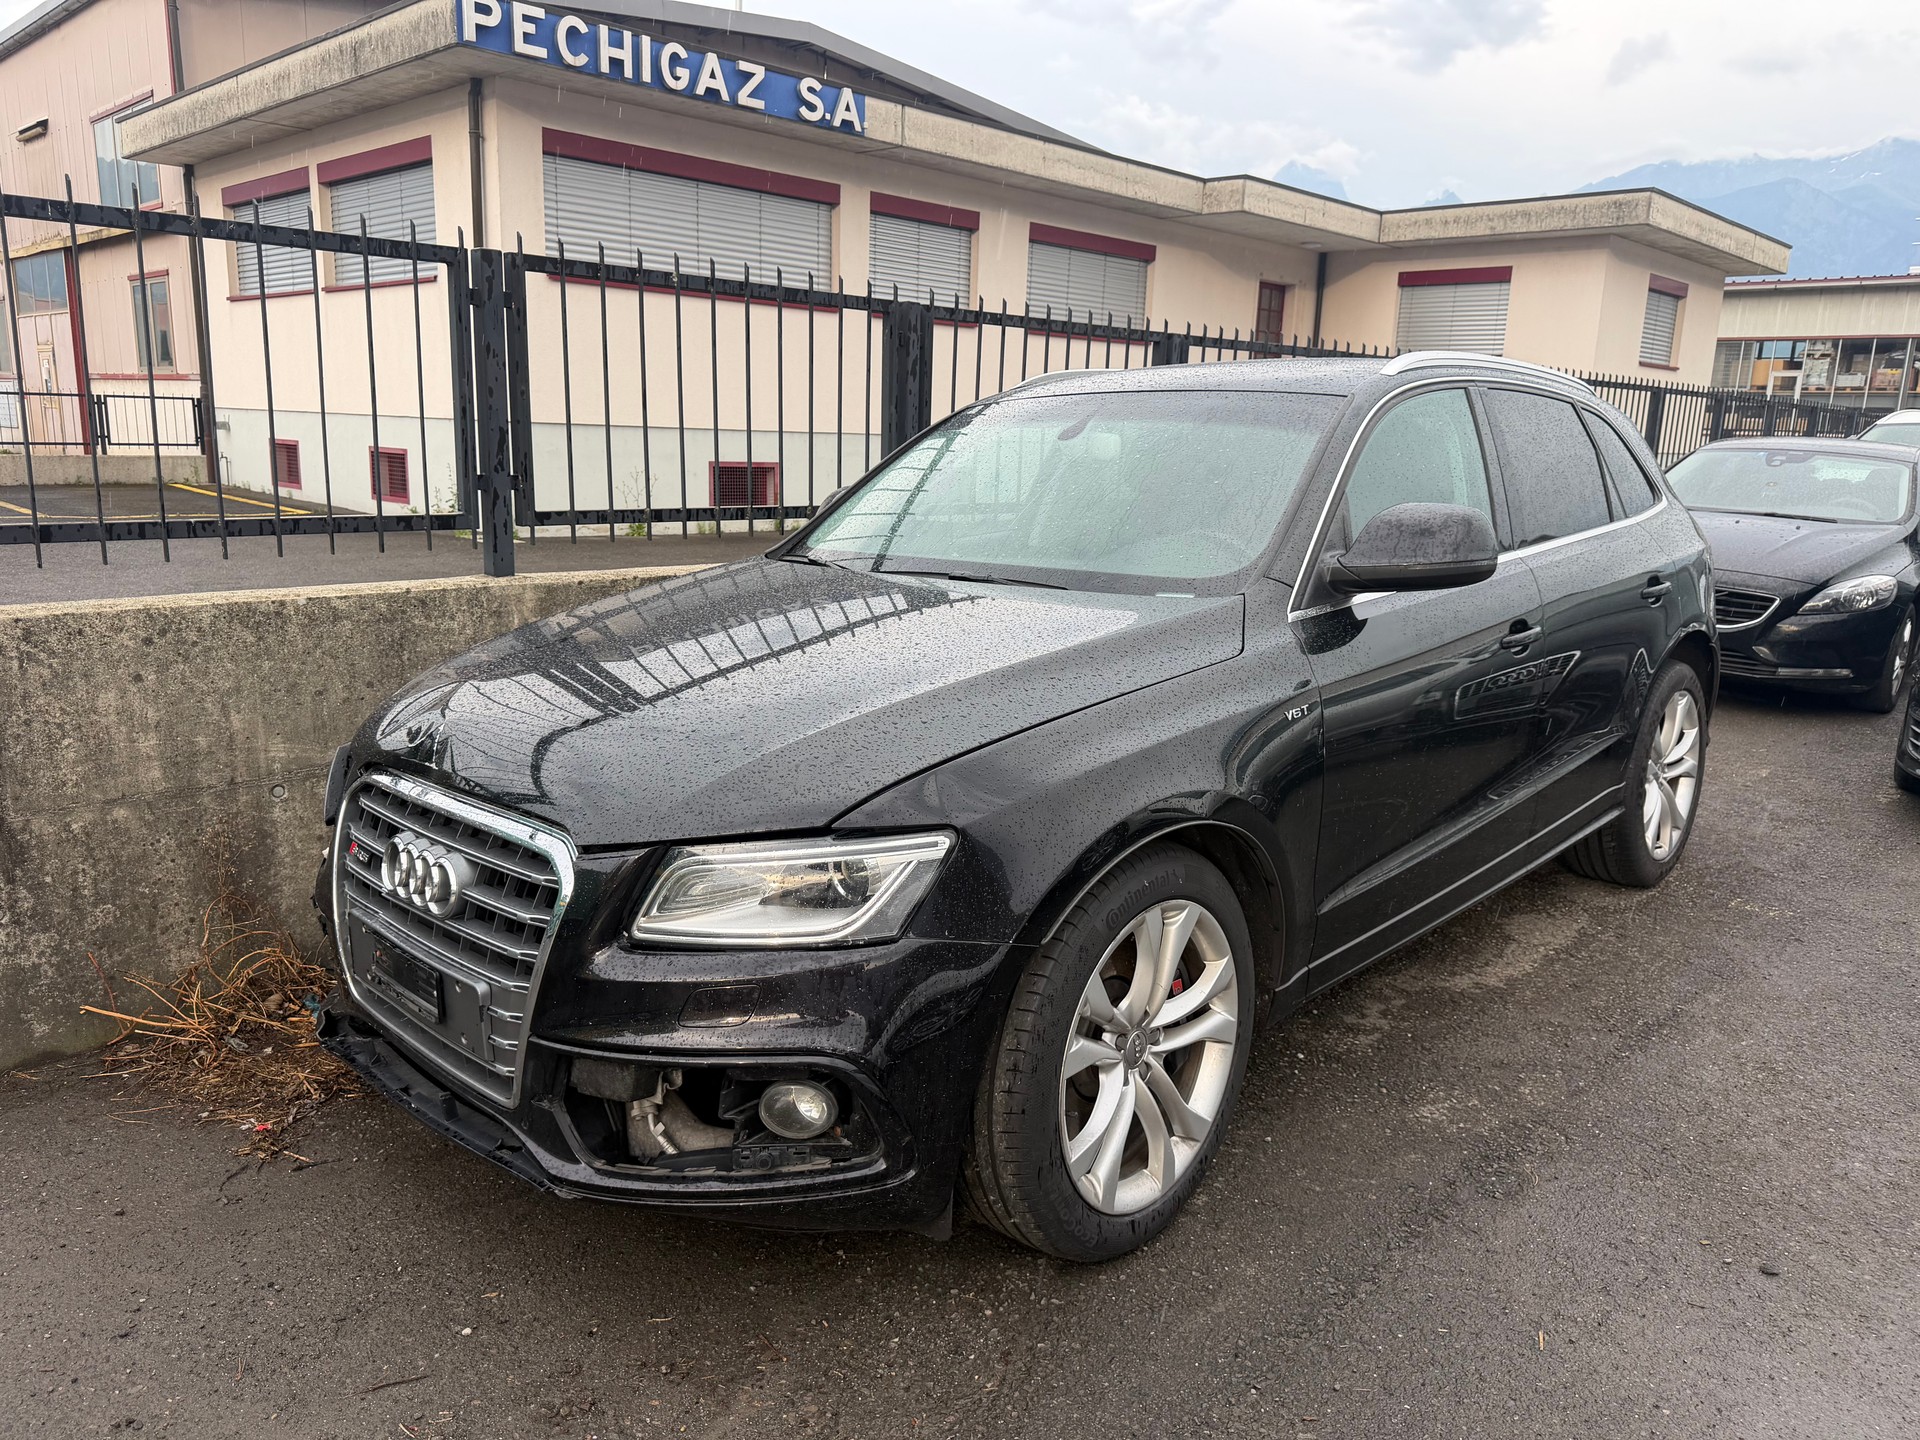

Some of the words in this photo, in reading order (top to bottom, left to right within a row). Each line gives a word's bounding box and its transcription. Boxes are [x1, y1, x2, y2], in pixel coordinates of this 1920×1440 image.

[463, 0, 766, 111] PECHIGAZ
[1284, 704, 1309, 720] V6T
[1104, 869, 1171, 931] Continental
